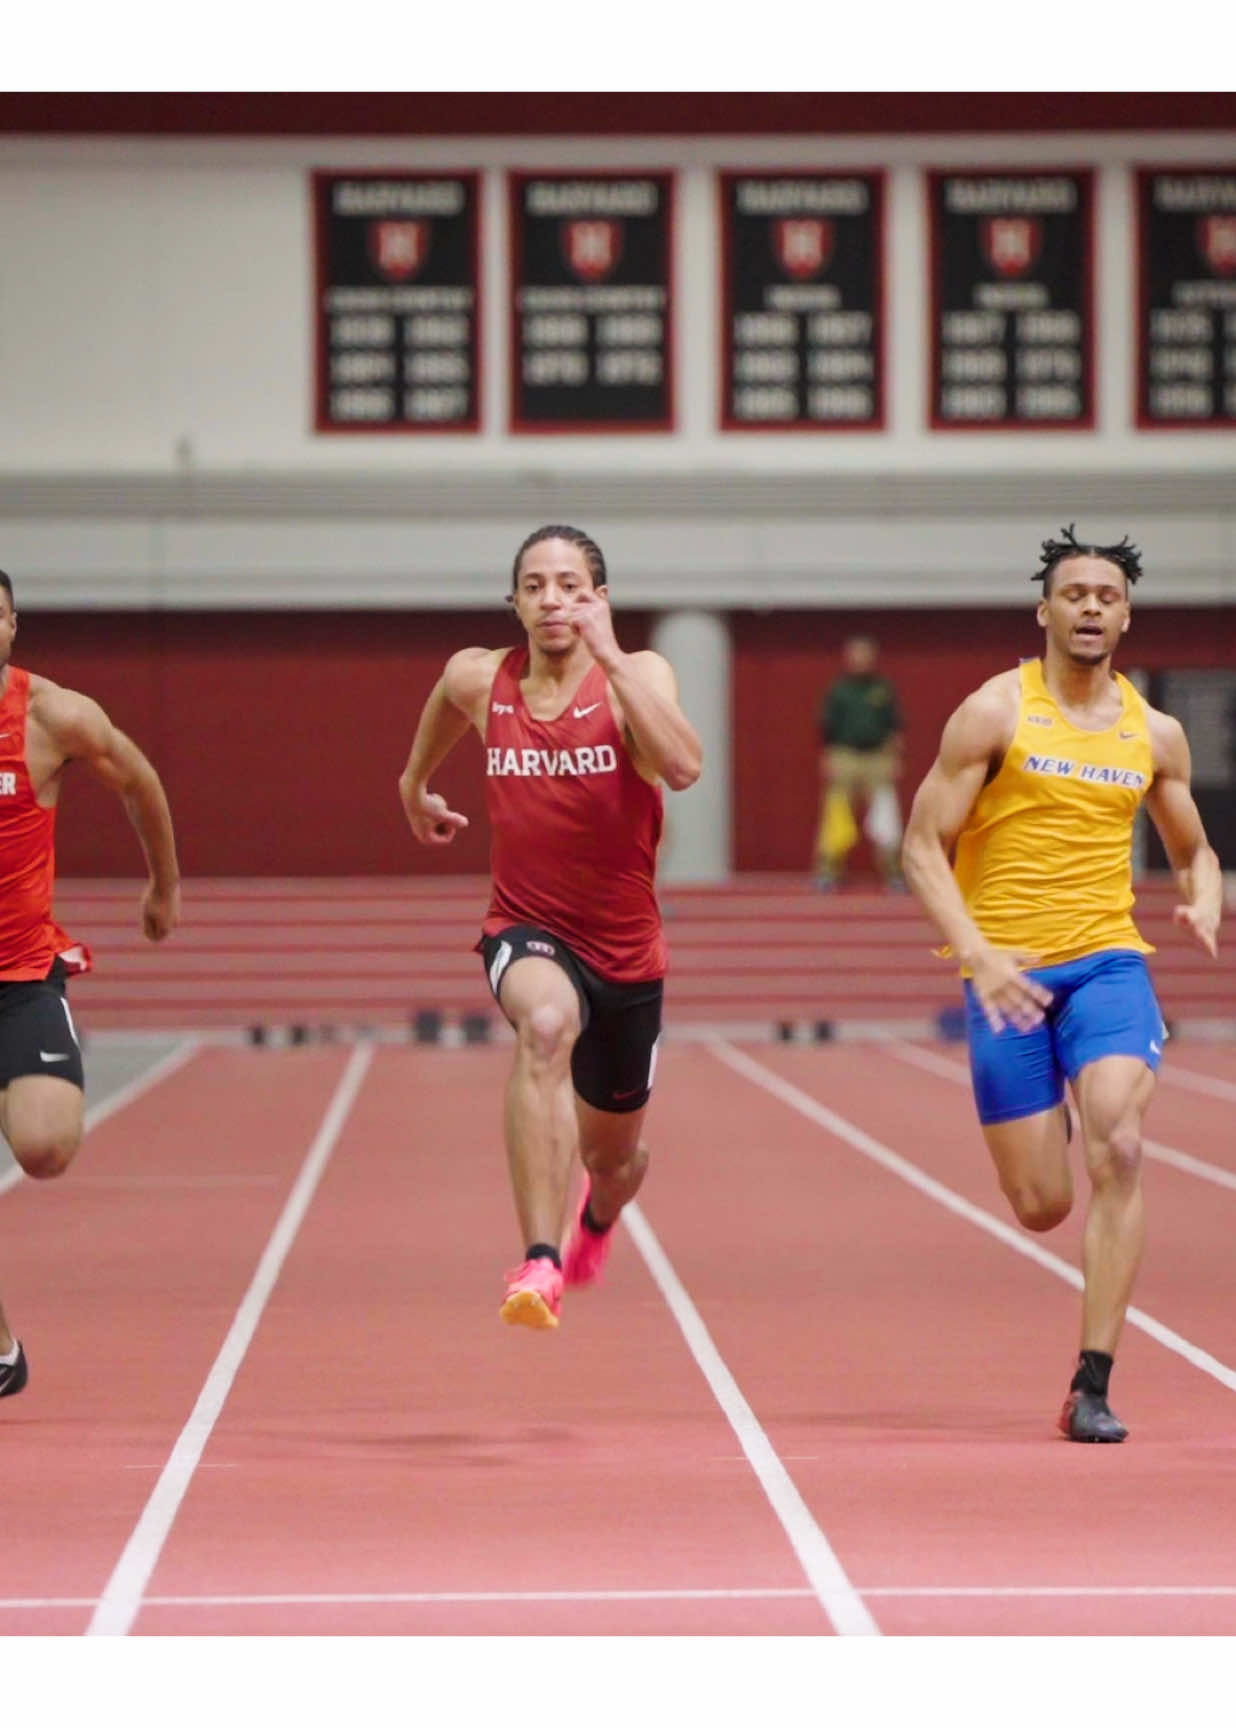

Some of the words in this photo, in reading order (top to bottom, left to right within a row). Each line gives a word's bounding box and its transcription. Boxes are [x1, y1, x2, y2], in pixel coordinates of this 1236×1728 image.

[486, 745, 617, 776] HARVARD
[1023, 755, 1076, 777] NEW
[1080, 763, 1147, 789] HAVEN
